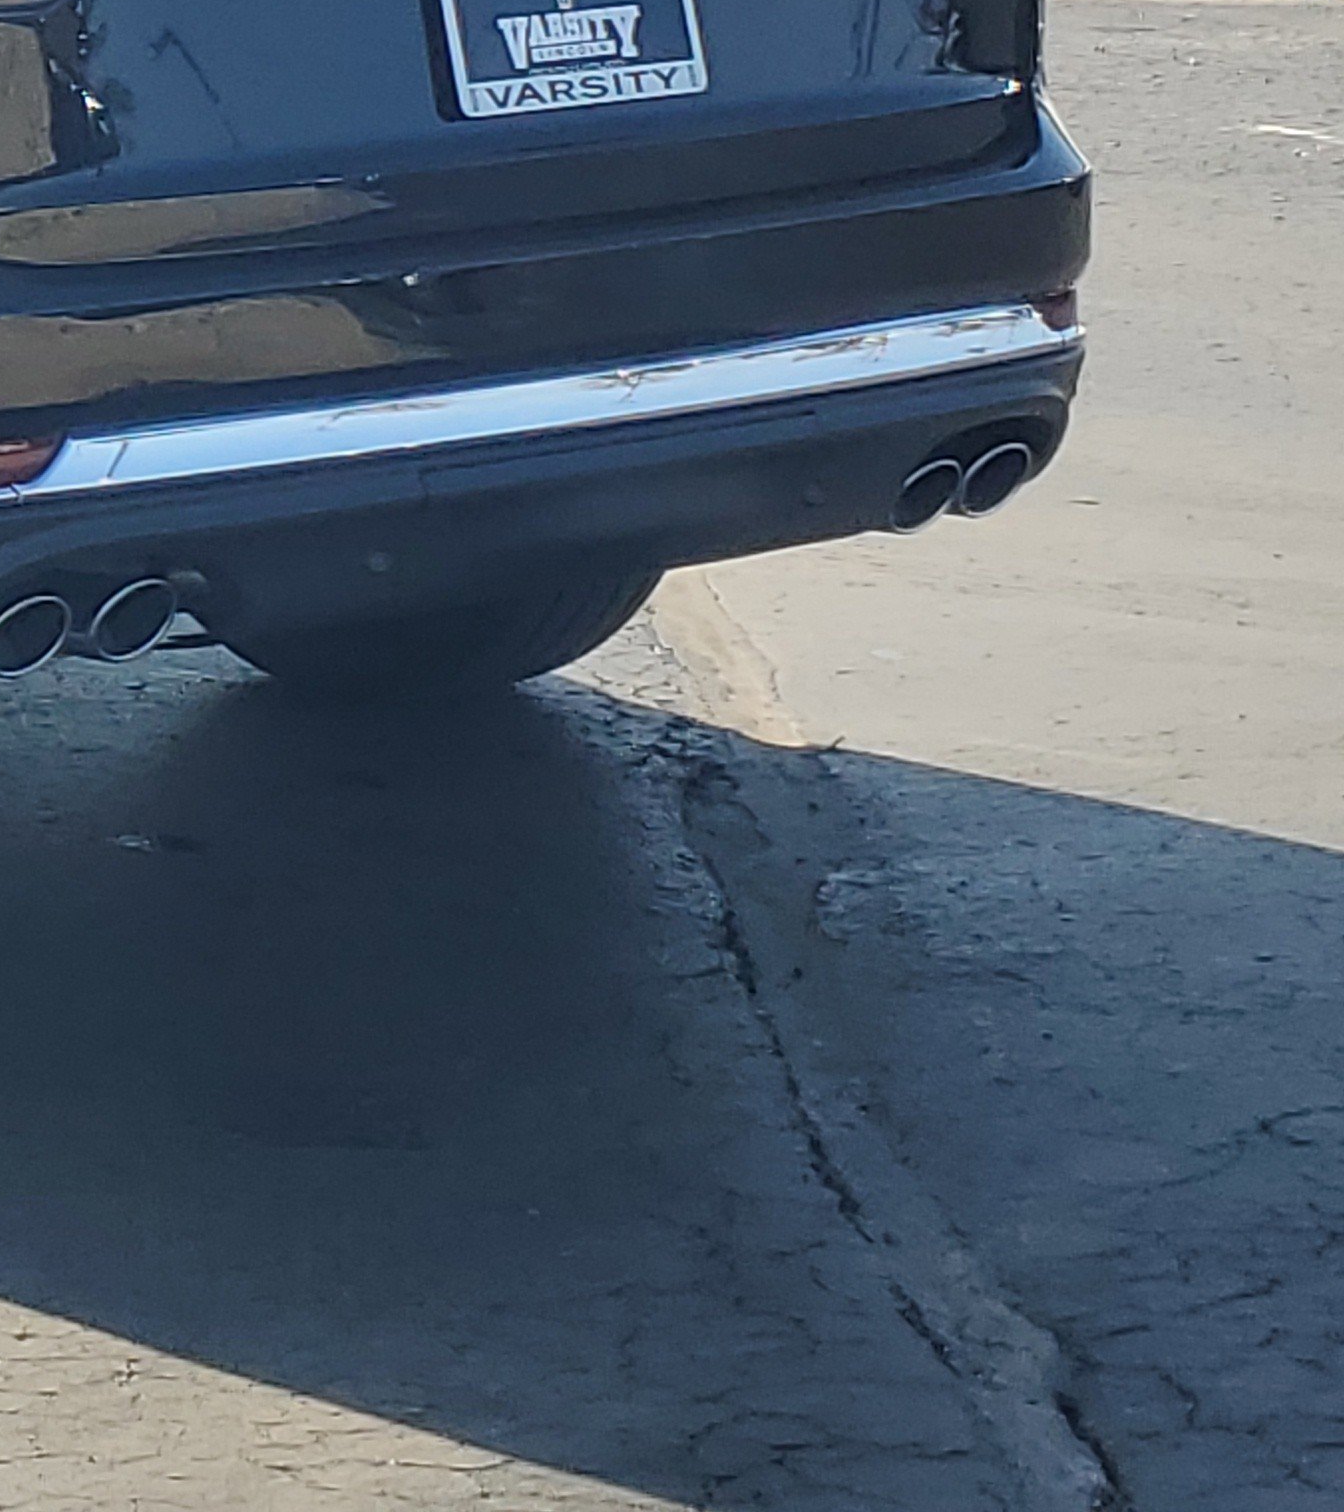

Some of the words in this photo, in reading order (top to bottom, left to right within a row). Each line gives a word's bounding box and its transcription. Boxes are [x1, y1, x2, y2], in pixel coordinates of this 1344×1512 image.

[496, 3, 642, 70] VARSITY
[537, 42, 610, 60] LINCOLN
[484, 66, 680, 110] VARSITY
